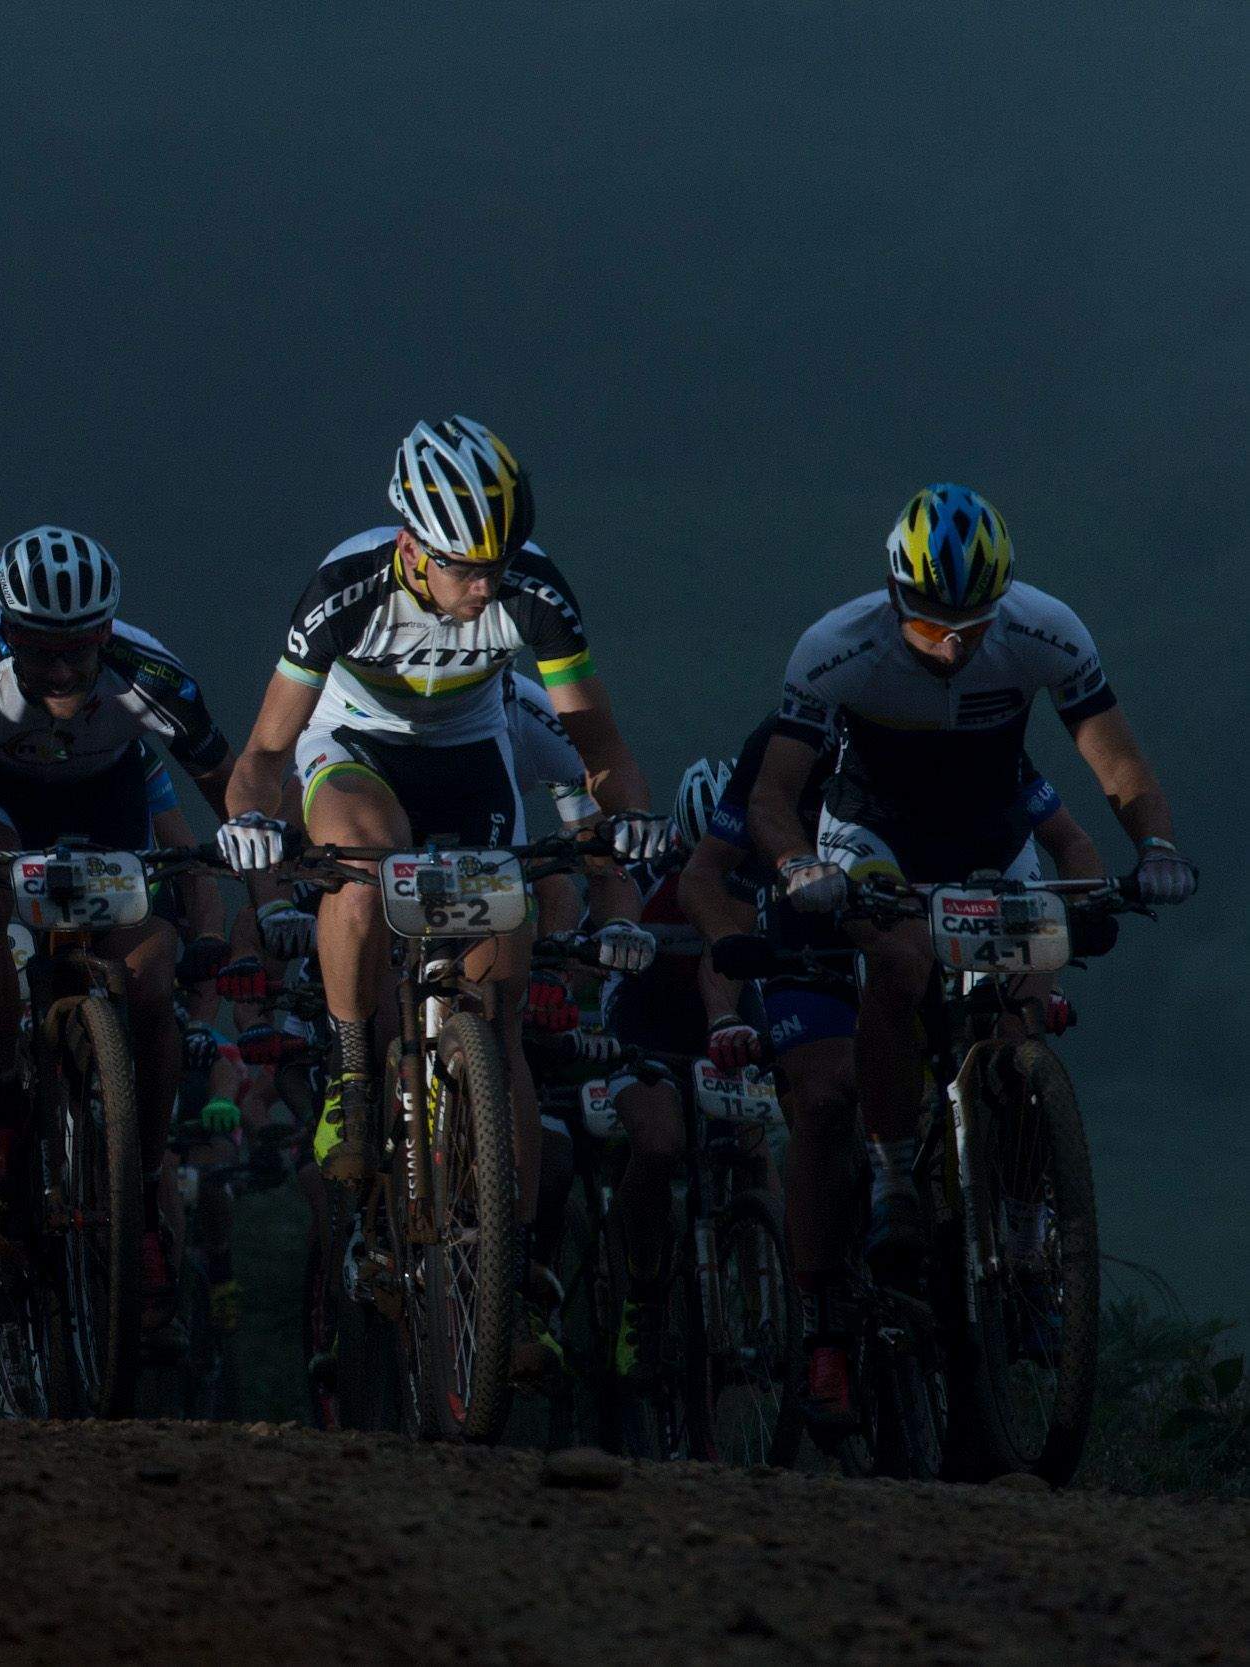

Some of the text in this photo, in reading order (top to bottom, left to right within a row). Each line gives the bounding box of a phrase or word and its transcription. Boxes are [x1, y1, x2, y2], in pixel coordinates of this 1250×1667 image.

[304, 563, 392, 636] SCOTT
[502, 568, 583, 634] SCOTT
[1008, 621, 1079, 657] BULLS
[425, 899, 490, 928] 6-2
[942, 917, 1000, 935] CAPE
[973, 940, 1031, 966] 4-1
